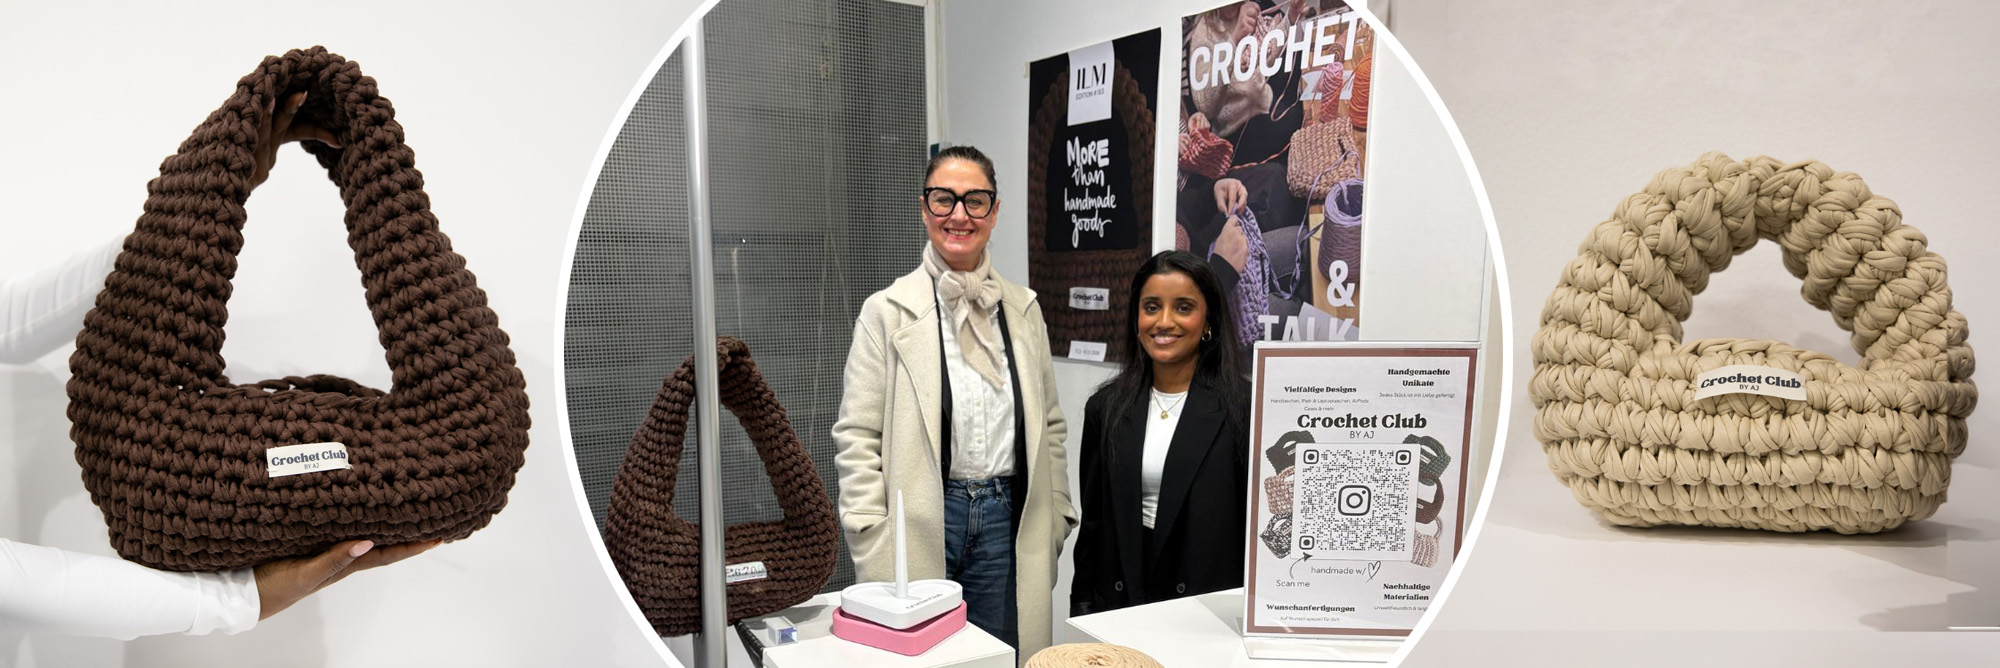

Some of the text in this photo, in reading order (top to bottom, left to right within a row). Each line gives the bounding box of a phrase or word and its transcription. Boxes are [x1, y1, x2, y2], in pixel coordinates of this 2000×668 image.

[1190, 10, 1360, 91] CROCHET
[1076, 62, 1106, 90] ILM
[1067, 136, 1110, 168] MORE
[1071, 162, 1105, 187] than
[1064, 185, 1117, 211] handmade
[1071, 209, 1112, 249] goods
[1326, 260, 1356, 307] &
[1387, 368, 1451, 376] Handgemachte
[1402, 379, 1435, 387] Unikate
[1700, 373, 1802, 389] Crochet Club
[1325, 386, 1357, 394] Designs
[1297, 413, 1427, 428] Crochet Club
[1350, 431, 1375, 439] BY AJ
[271, 449, 346, 467] Crochet Club
[1311, 567, 1367, 576] handmade w/
[1276, 579, 1296, 587] Scan
[1383, 583, 1431, 591] Nachhaltige
[1383, 593, 1429, 601] Materialien
[1266, 604, 1355, 613] Wunschanfertigungen
